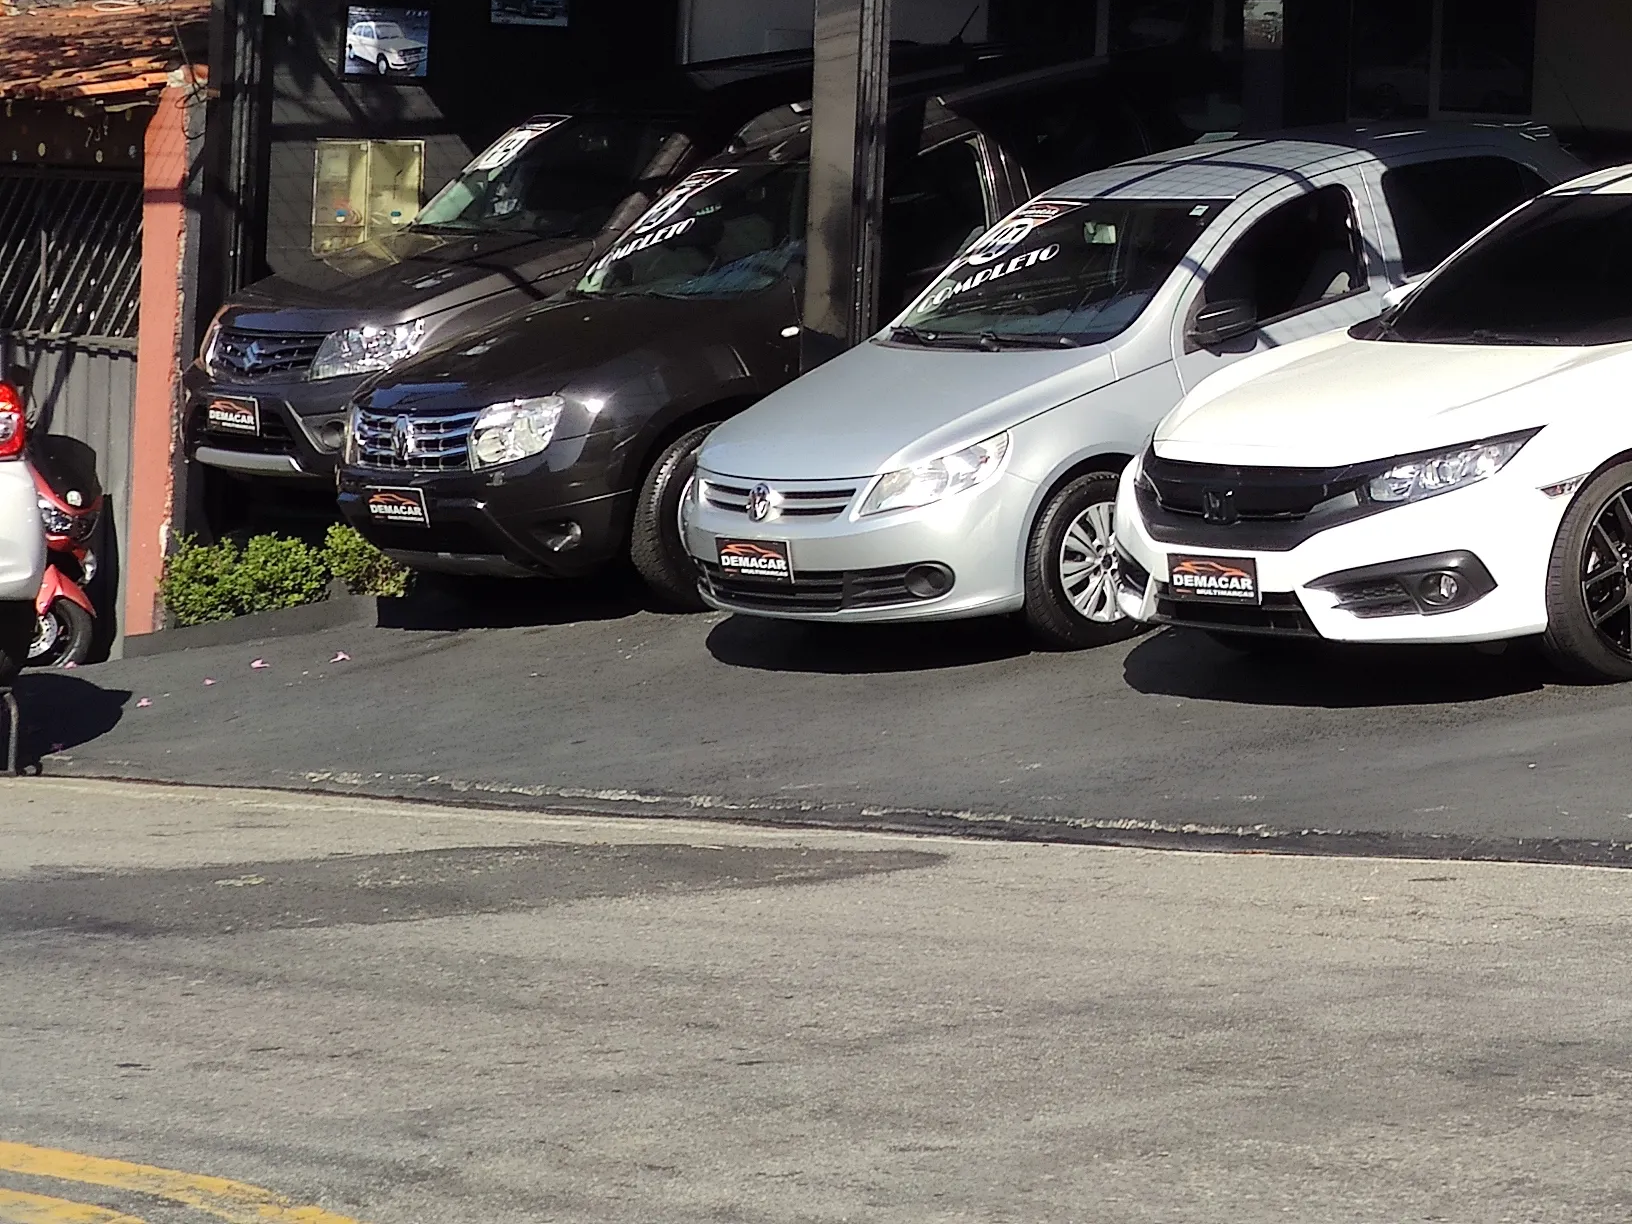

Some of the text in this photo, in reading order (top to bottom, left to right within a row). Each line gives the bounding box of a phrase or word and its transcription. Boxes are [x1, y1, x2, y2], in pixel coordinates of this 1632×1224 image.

[917, 243, 1060, 313] COMPLETO
[209, 410, 255, 425] DEMACAR
[369, 504, 423, 516] DEMACAR
[721, 555, 787, 570] DEMACAR
[1173, 574, 1254, 590] DEMACAR
